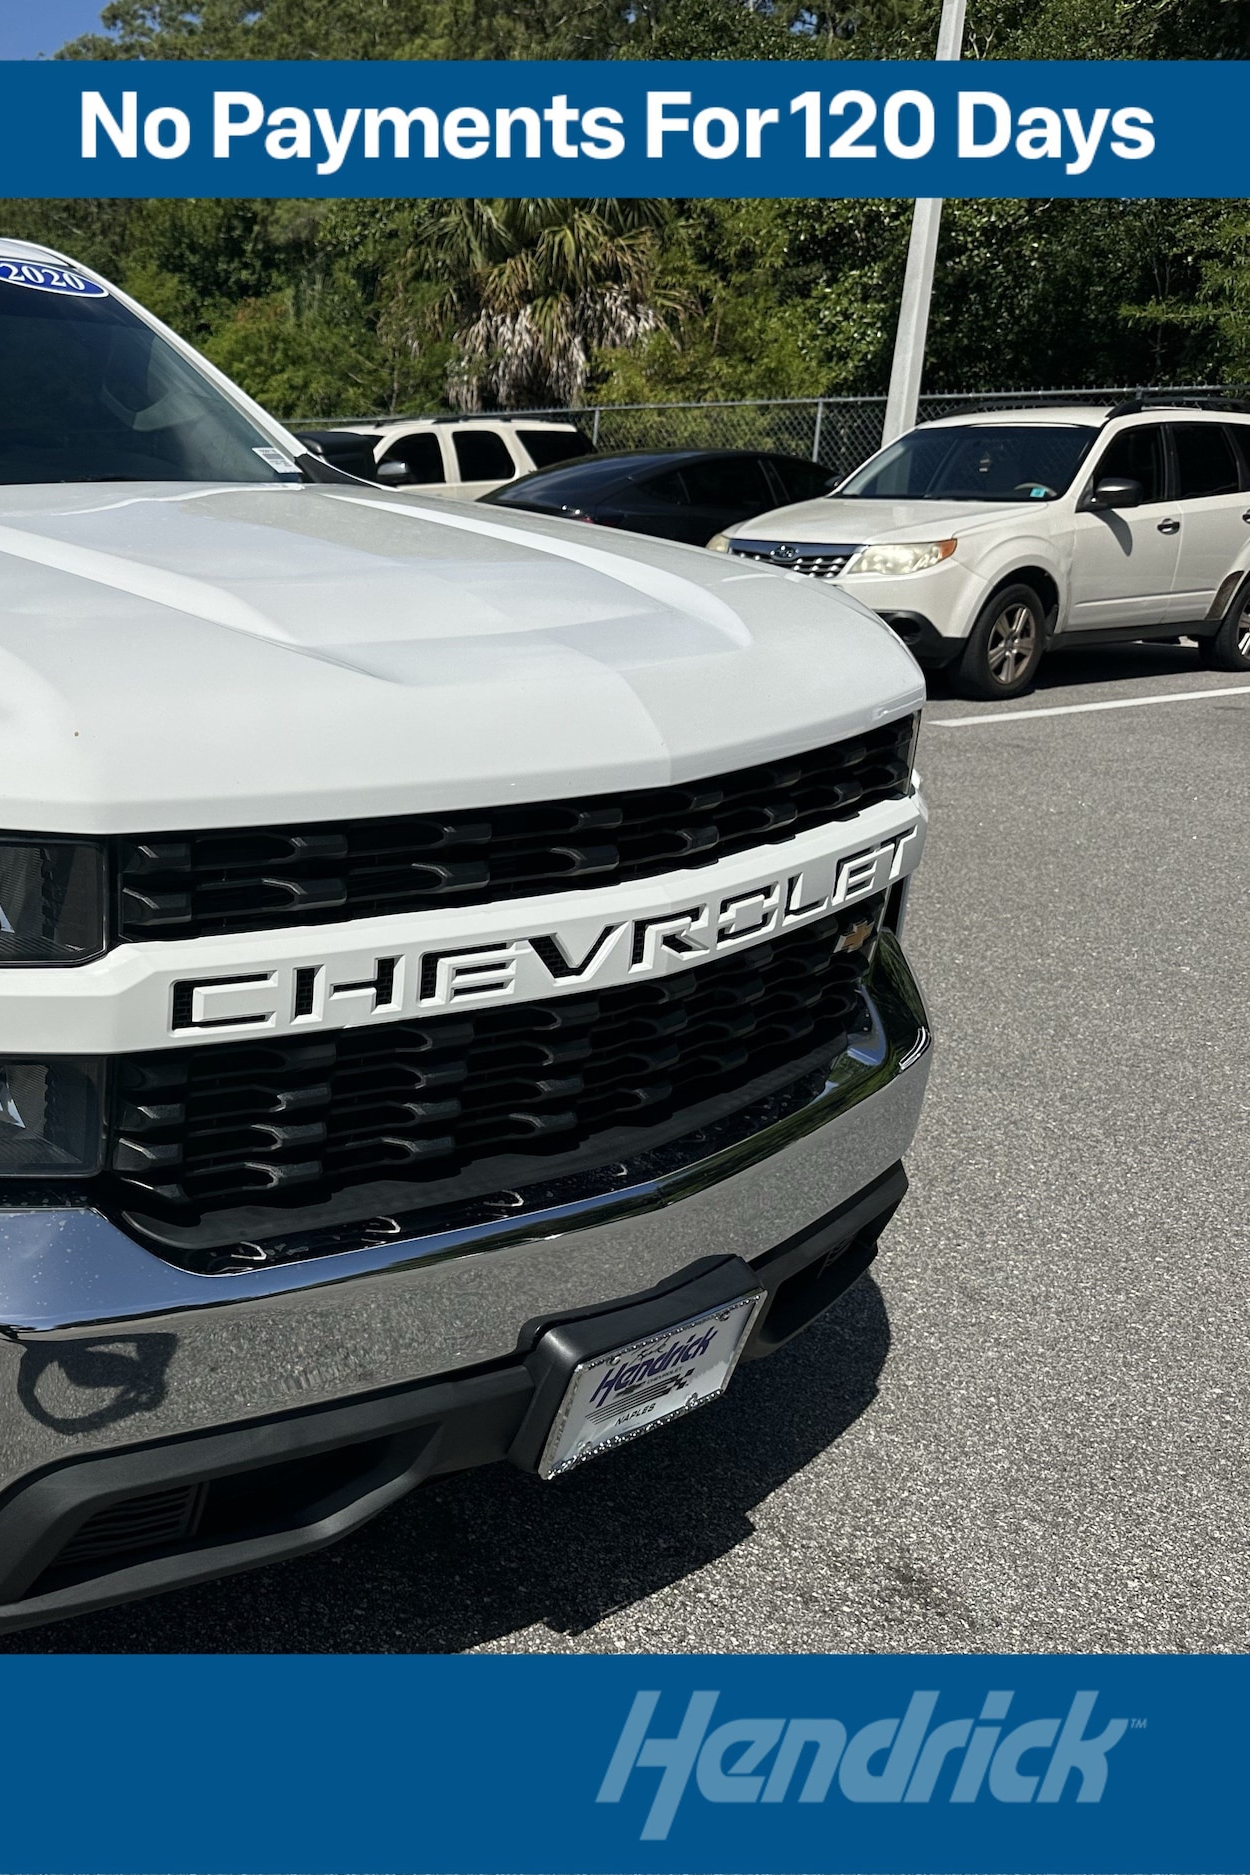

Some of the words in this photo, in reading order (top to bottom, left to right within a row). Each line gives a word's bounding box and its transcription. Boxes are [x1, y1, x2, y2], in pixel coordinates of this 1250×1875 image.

[170, 824, 918, 1032] CHEVROLET
[589, 1326, 718, 1407] Hendrick
[615, 1403, 656, 1427] NAPLES
